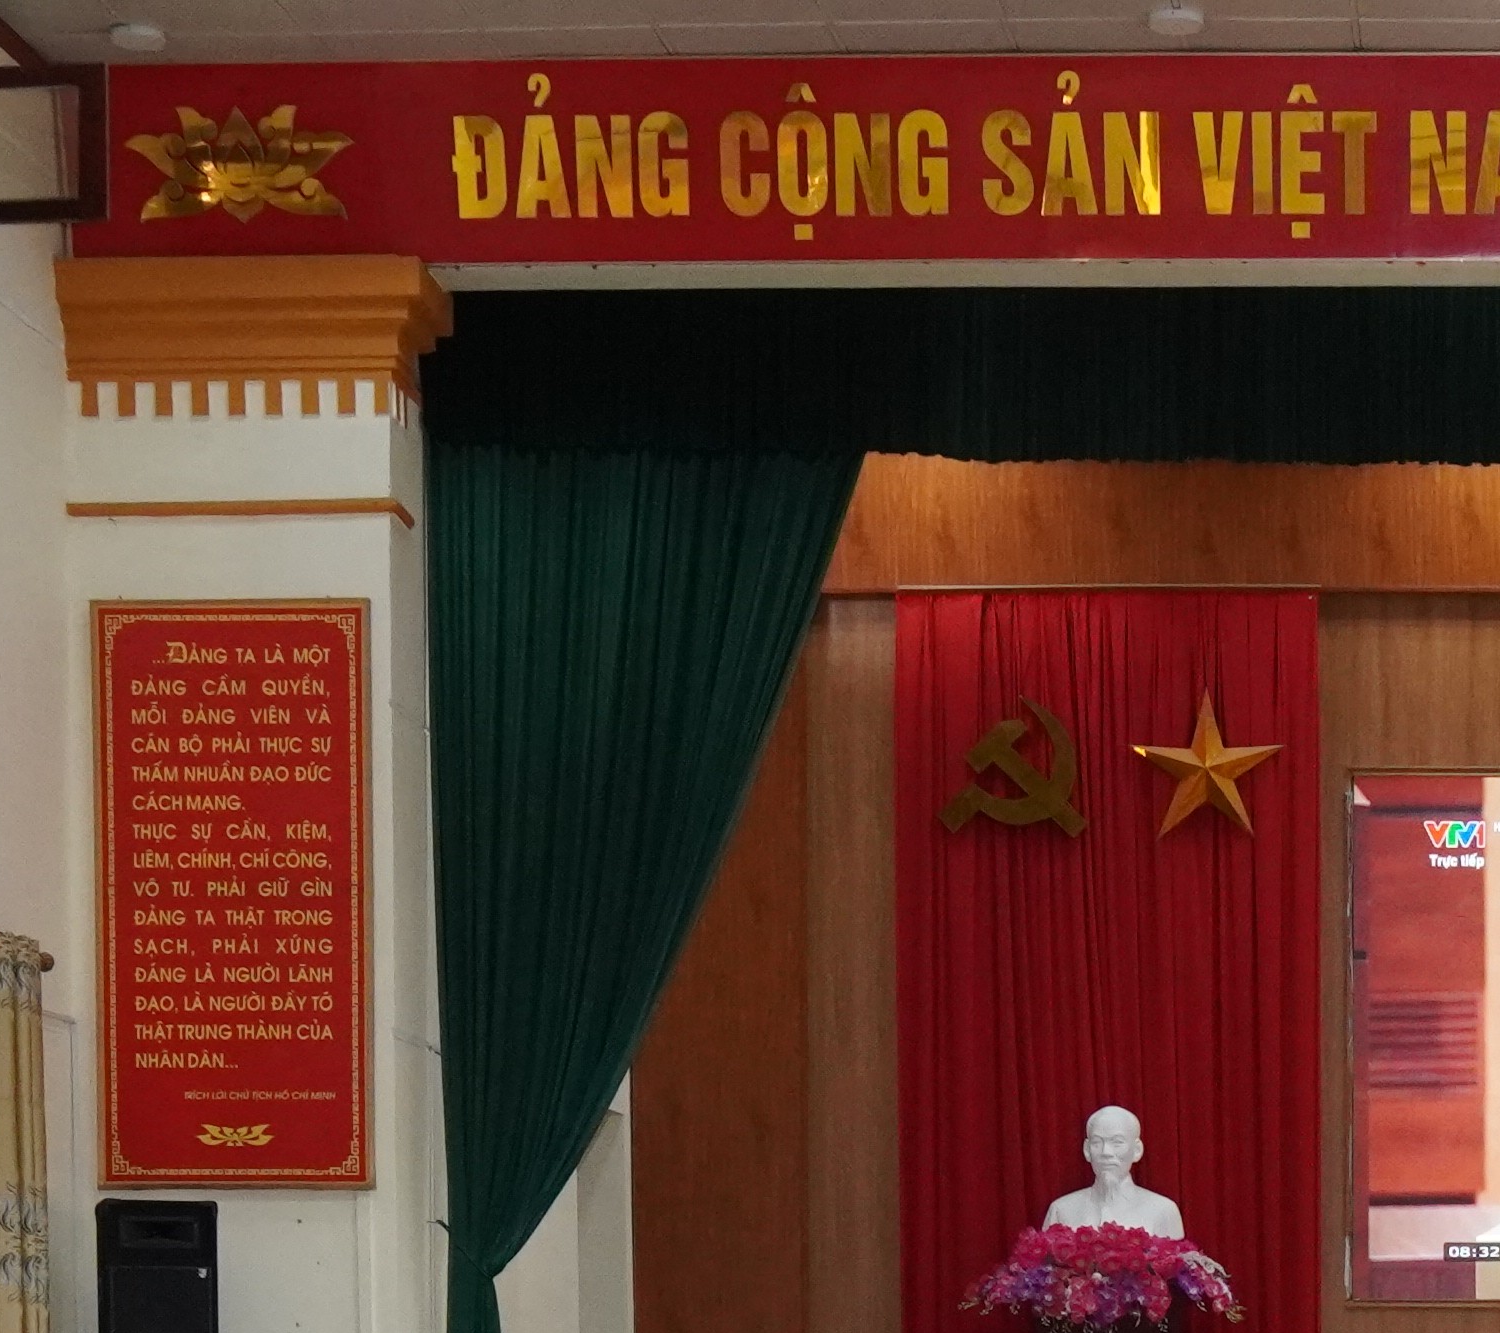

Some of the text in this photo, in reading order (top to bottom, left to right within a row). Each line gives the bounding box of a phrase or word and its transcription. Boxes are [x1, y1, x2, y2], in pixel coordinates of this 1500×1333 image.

[452, 73, 689, 219] ĐẢNG
[720, 83, 948, 240] CỘNG
[982, 70, 1161, 216] SẢN
[1193, 84, 1377, 239] VIỆT
[153, 642, 330, 667] ...ĐẢNG TA LÀ MỘT
[131, 674, 329, 696] ĐẢNG CẦM QUYỀN,
[132, 702, 331, 724] MỖI ĐẢNG VIÊN VÀ
[132, 732, 331, 756] CÁN BỘ PHẢI THỰC SỰ
[132, 760, 331, 784] THẤM NHUẦN ĐẠO ĐỨC
[133, 791, 245, 814] CÁCH MẠNG.
[133, 818, 331, 843] THỰC SỰ CẦN, KIỆM,
[1424, 820, 1486, 849] VTV1
[134, 848, 331, 869] LIÊM, CHÍNH, CHÍ CÔNG,
[1429, 852, 1485, 869] Trực tiếp
[134, 876, 332, 897] VÔ TƯ. PHẢI GIỮ GÌN
[1448, 1245, 1500, 1258] 08:32
